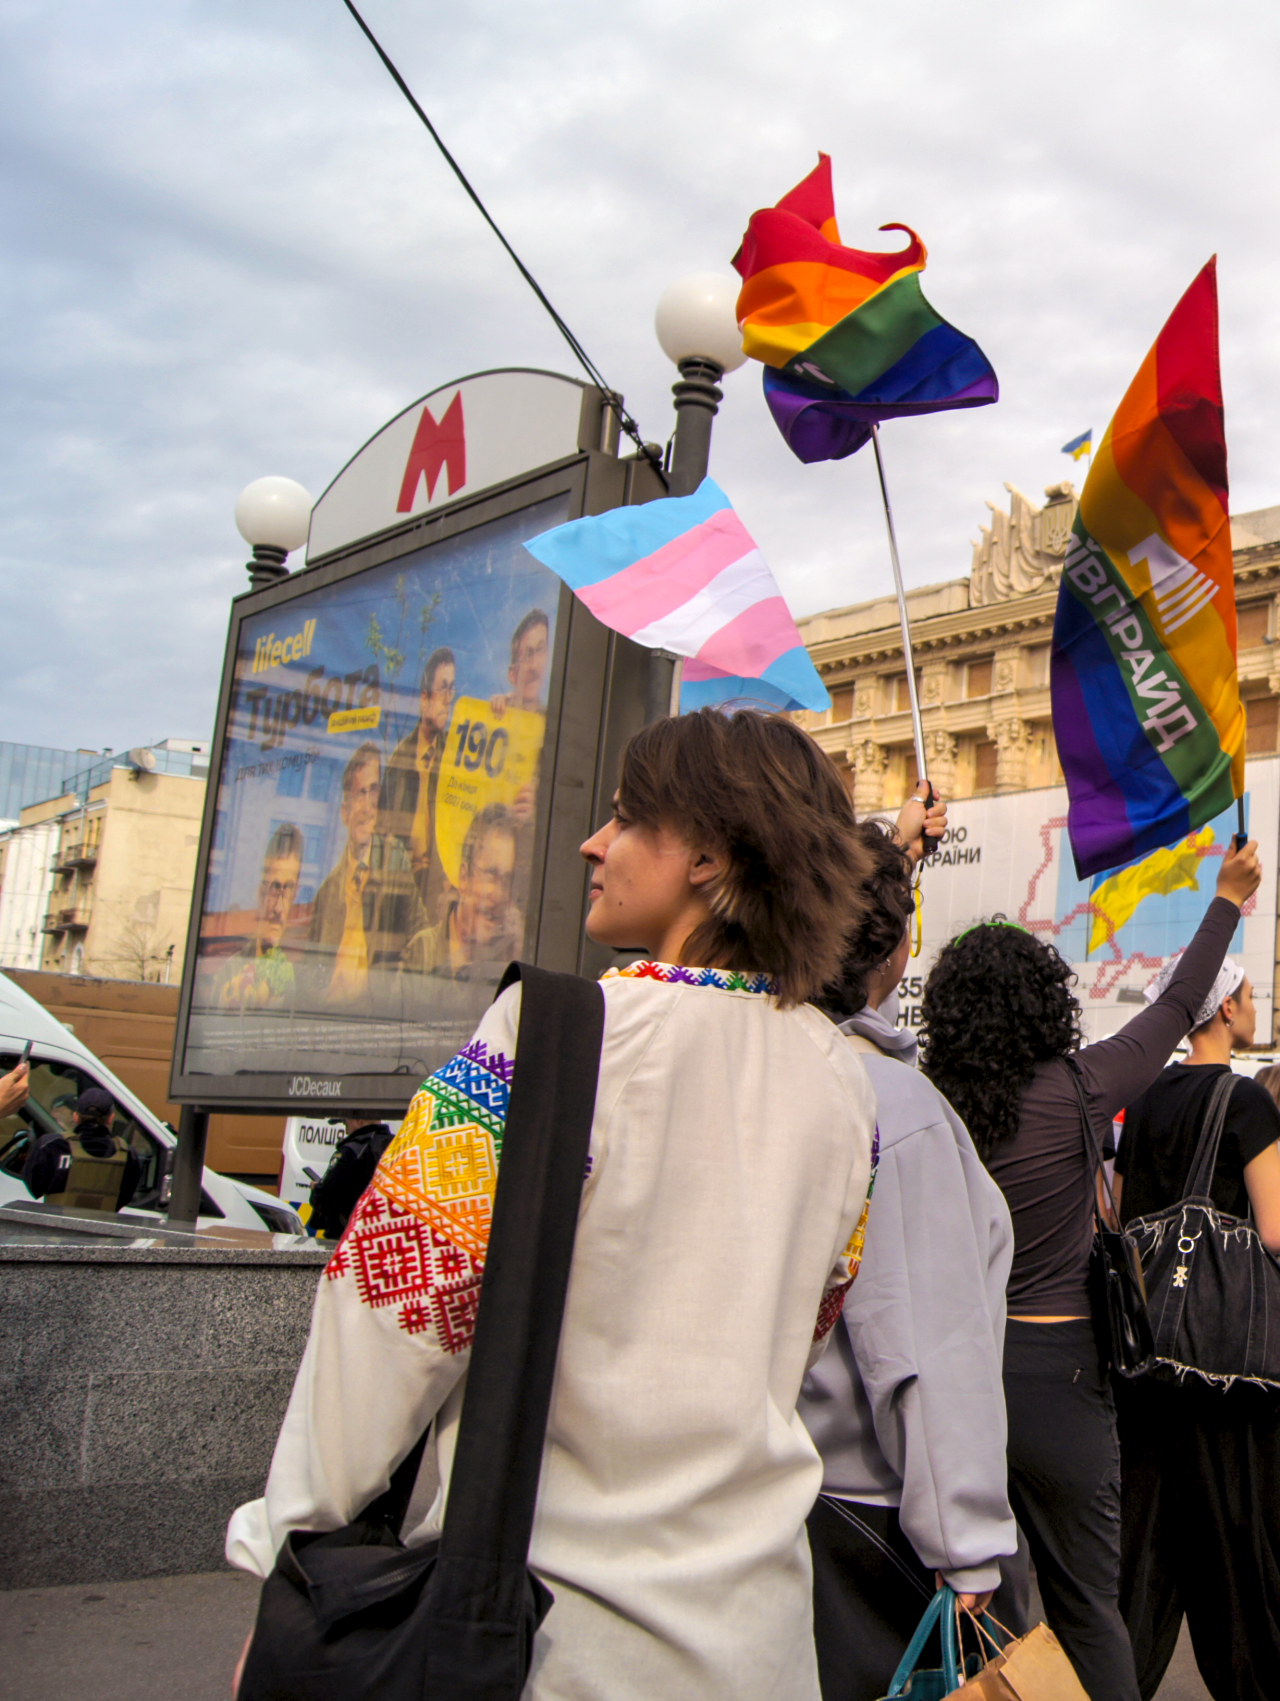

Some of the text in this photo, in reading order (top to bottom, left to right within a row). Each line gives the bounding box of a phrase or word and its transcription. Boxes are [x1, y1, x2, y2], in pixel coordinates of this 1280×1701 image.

[252, 618, 316, 673] lifecell
[246, 664, 381, 752] Турбота
[454, 719, 509, 778] 190
[922, 845, 981, 867] КРАЇНИ
[288, 1077, 342, 1096] JCDecaux
[299, 1125, 345, 1146] ПОЛІЦІЯ
